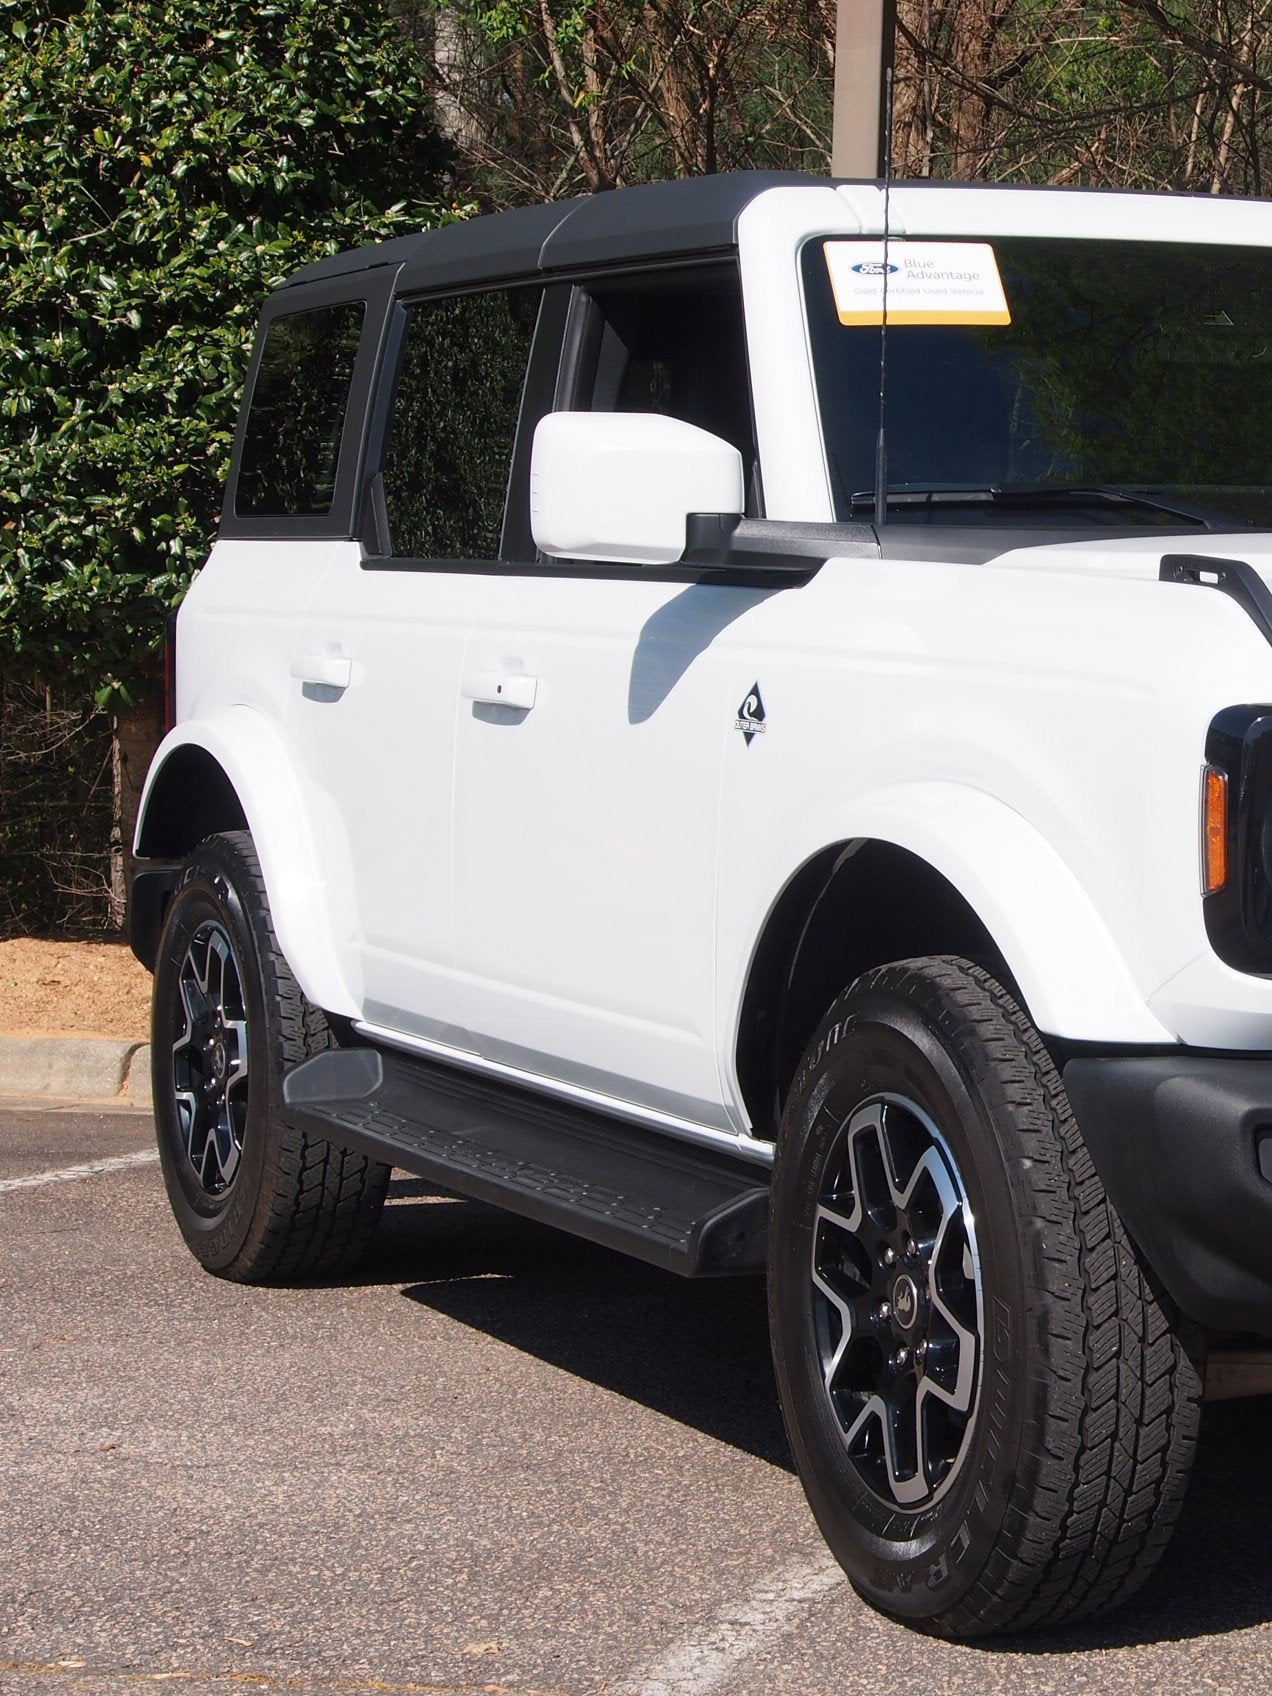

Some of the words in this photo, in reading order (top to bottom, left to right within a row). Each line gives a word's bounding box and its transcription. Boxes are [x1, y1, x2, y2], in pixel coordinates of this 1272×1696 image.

[904, 259, 935, 269] Blue
[907, 270, 980, 281] Advantage
[855, 287, 877, 295] Gold
[923, 287, 948, 295] Used
[951, 288, 984, 296] Vehicle
